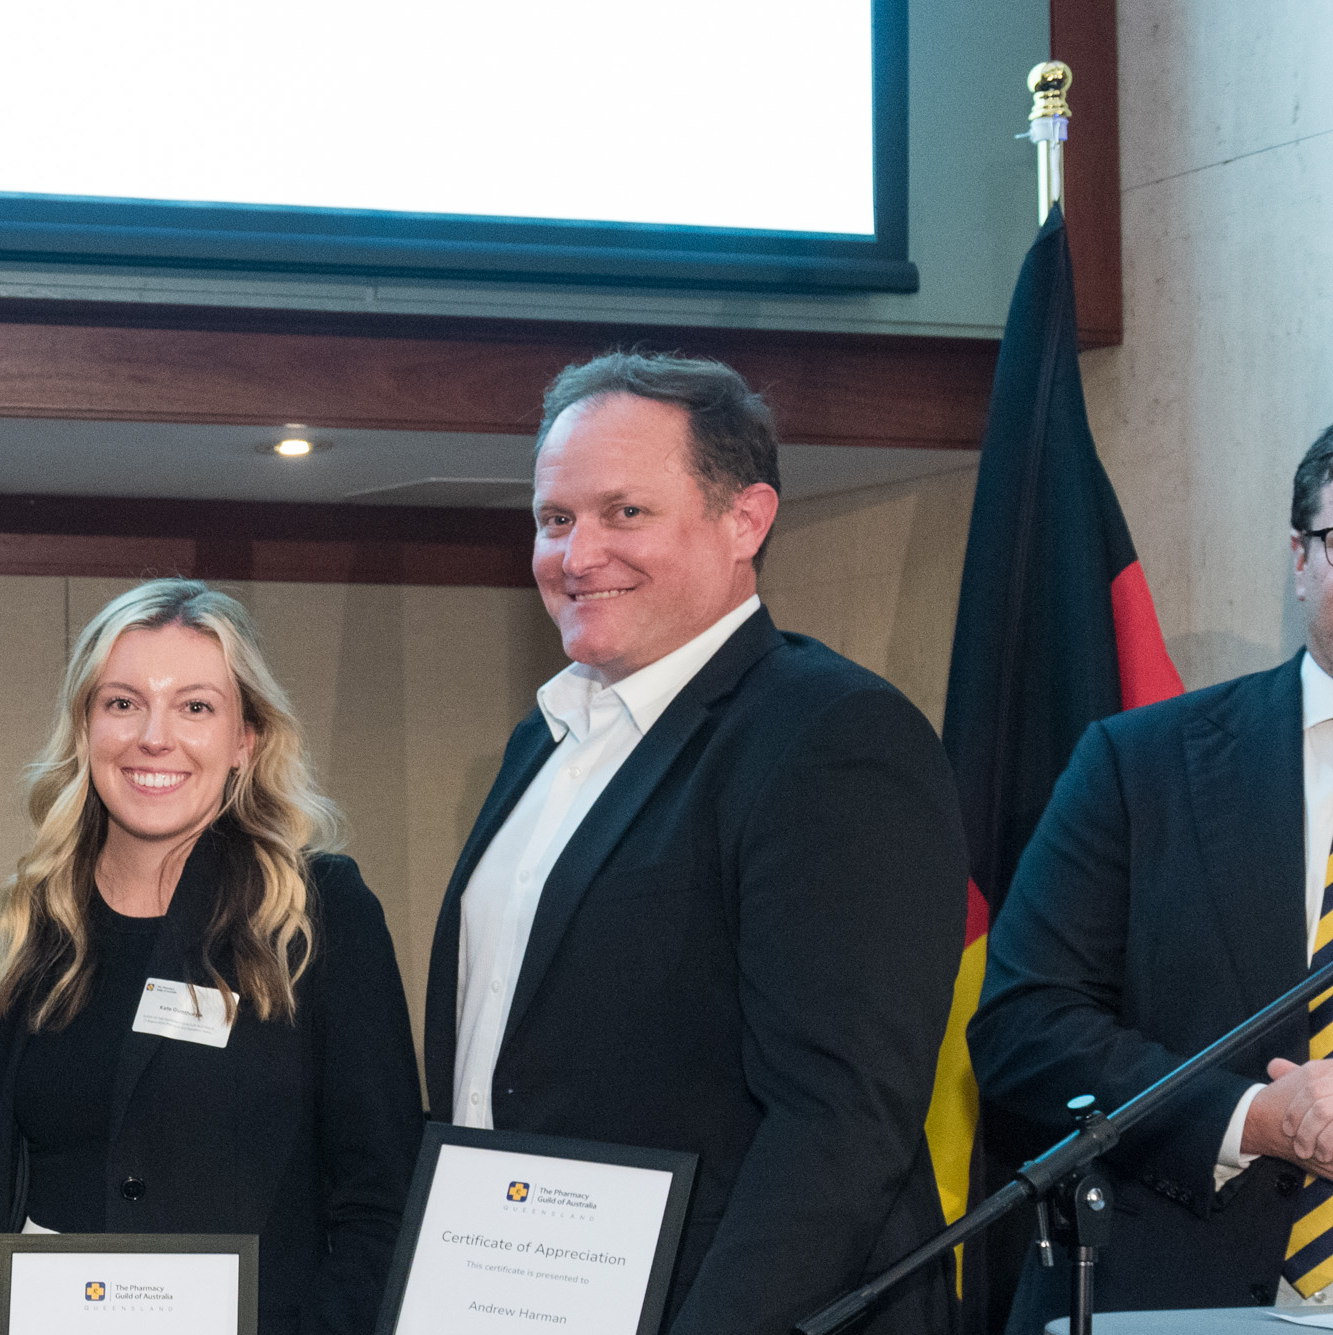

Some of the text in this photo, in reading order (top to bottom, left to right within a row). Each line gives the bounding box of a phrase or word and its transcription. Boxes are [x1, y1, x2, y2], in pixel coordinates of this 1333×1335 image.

[537, 1196, 557, 1204] Guild
[566, 1199, 597, 1209] Australia
[540, 1187, 590, 1201] The Pharmacy
[503, 1205, 595, 1222] QUEENSLAND
[442, 1230, 626, 1266] Certificate of Appreciation
[466, 1260, 590, 1285] This certificate is presented to
[129, 1285, 165, 1293] Pharmacy
[468, 1301, 567, 1324] Andrew Harman
